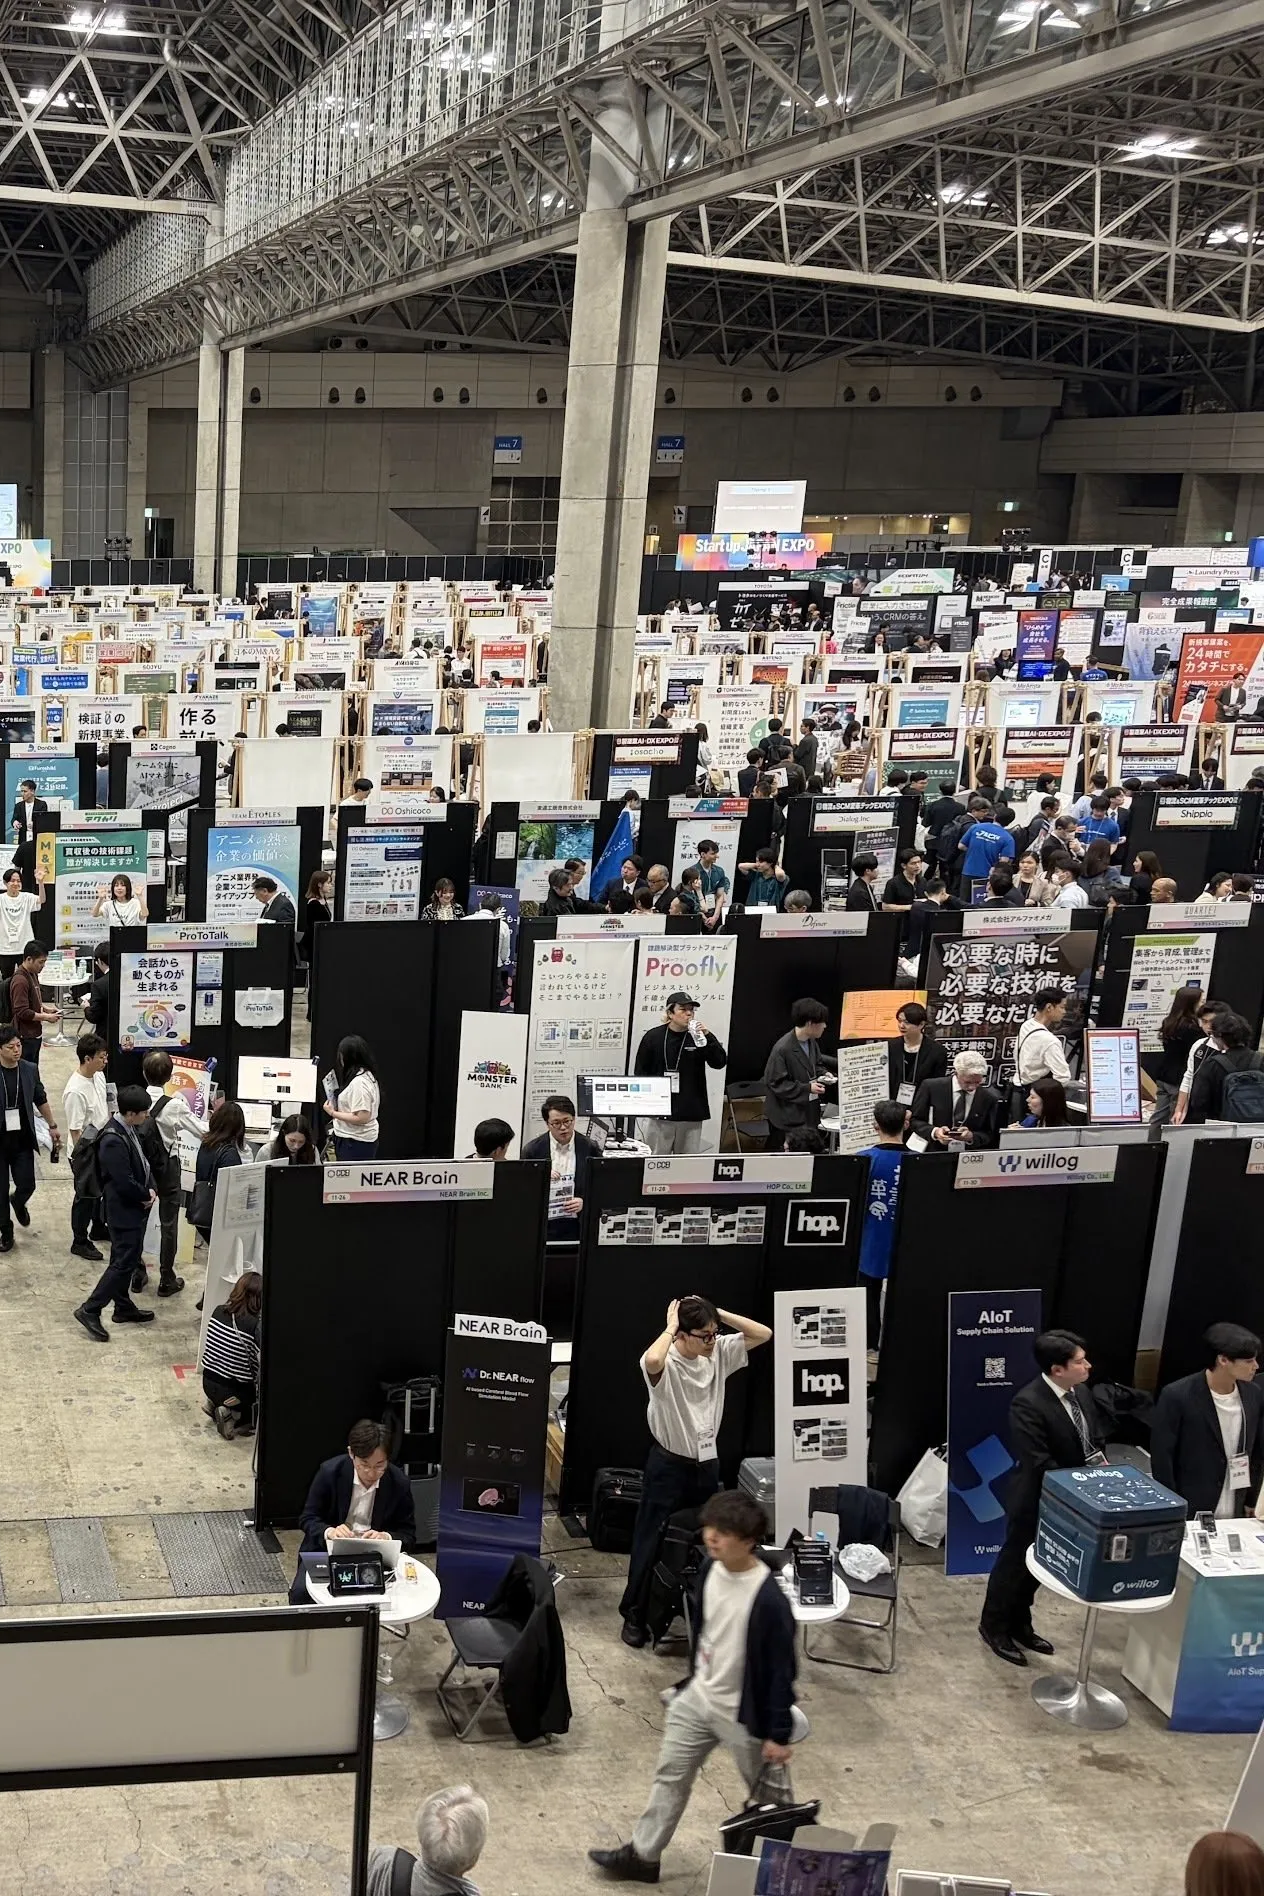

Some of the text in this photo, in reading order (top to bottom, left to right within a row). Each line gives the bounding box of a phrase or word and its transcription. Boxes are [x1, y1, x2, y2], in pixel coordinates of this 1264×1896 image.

[512, 439, 518, 448] 7
[675, 438, 681, 448] 7
[781, 538, 815, 551] EXPO
[1041, 554, 1049, 563] C
[1123, 553, 1131, 563] C
[1194, 568, 1240, 577] Laundry Press
[1186, 647, 1230, 661] 24時間で
[1184, 660, 1249, 674] カタチにする。
[179, 707, 217, 726] 作る
[395, 806, 432, 816] Oshicoco
[1180, 809, 1213, 820] Shippio
[66, 857, 140, 868] 誰が解決しますか？
[983, 914, 1052, 924] 株式会社アルファオメガ
[179, 930, 229, 941] ProToTalk
[942, 942, 1060, 968] 必要な時に
[138, 957, 179, 969] 会話から
[645, 954, 728, 983] Proofly
[132, 969, 185, 981] 動くものが
[540, 972, 608, 980] こいつらやるよと
[137, 981, 179, 992] 生まれる
[539, 982, 608, 990] 言われているけど
[938, 971, 1078, 997] 必要な技術を
[467, 1074, 518, 1085] MONSTER
[1025, 1152, 1079, 1172] willog
[718, 1163, 741, 1178] hop.
[361, 1169, 458, 1187] NEAR Brain
[458, 1190, 476, 1198] Brain
[797, 1210, 840, 1237] hop.
[978, 1310, 1014, 1324] AIoT
[459, 1319, 543, 1339] NEAR Brain
[956, 1325, 1035, 1336] Supply Chain Solution
[520, 1375, 535, 1385] flow
[801, 1368, 845, 1398] hop.
[1087, 1468, 1124, 1479] willog
[1126, 1578, 1160, 1591] willog
[463, 1601, 485, 1611] NEAR
[1228, 1667, 1246, 1677] AIoT
